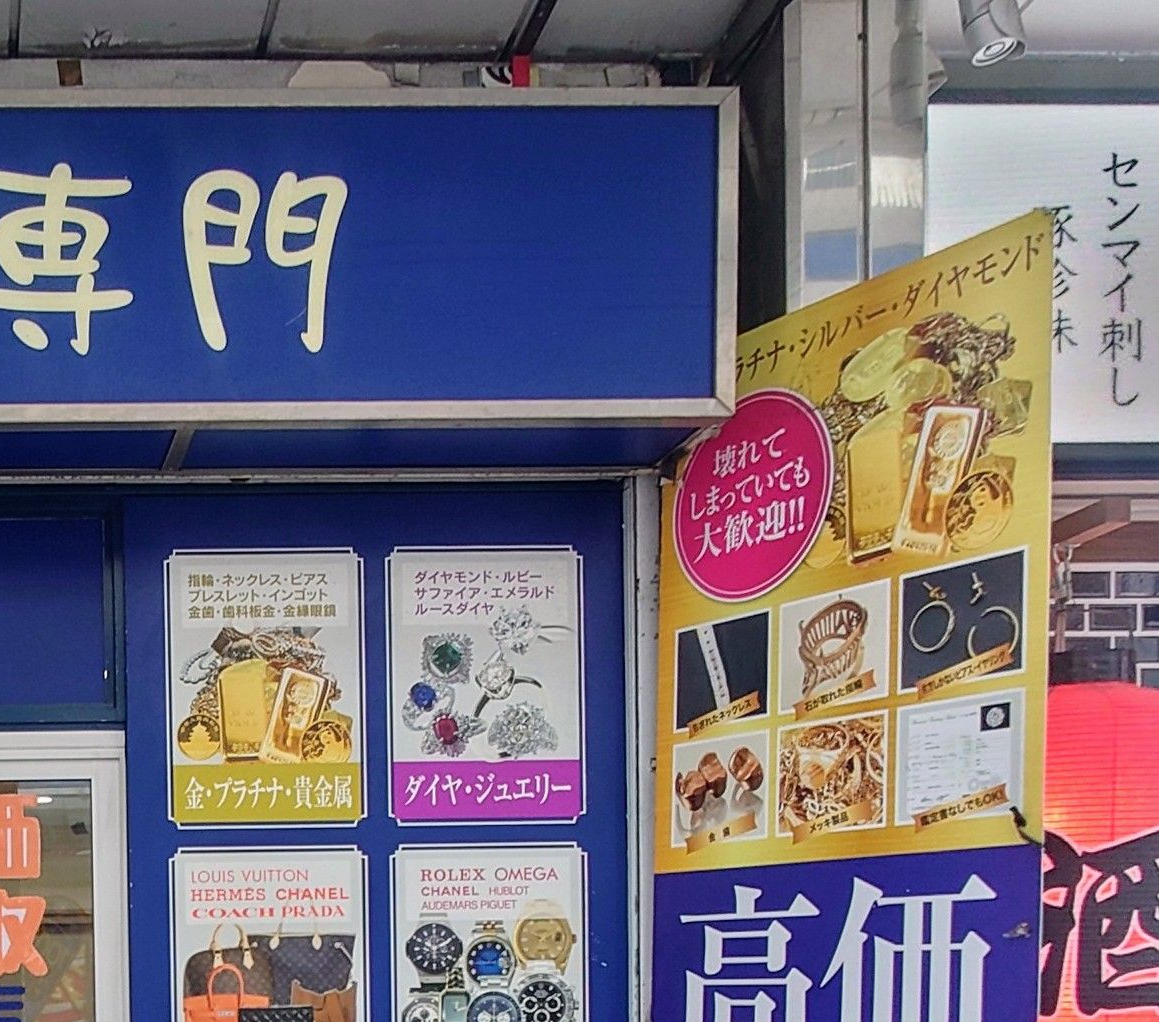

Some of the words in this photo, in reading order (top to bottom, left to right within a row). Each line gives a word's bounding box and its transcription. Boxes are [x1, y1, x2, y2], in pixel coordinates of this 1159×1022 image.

[1100, 152, 1144, 408] センマイ刺し
[713, 427, 788, 479] 壊れて
[689, 458, 811, 521] しまっていても
[693, 496, 806, 565] 大歓迎!!
[414, 570, 542, 585] ダイヤモンド・ルビー
[189, 588, 328, 603] ブレスレット・インゴット
[414, 585, 555, 600] サファイア・エメラルド
[414, 602, 494, 616] ルースダイヤ
[185, 775, 352, 810] 金・プラチナ・貴金属
[404, 773, 572, 807] ダイヤ・ジュエリー
[191, 870, 235, 883] LOUIS
[242, 868, 309, 882] VUITTON
[420, 868, 485, 882] ROLEX
[494, 867, 558, 881] OMEGA
[275, 887, 350, 900] CHANEL
[421, 885, 479, 897] CHANEL
[488, 885, 529, 896] HUBLOT
[192, 907, 275, 919] COACH
[281, 905, 345, 918] PRADA
[421, 900, 478, 911] AUDEMARS
[480, 899, 517, 910] PIGUET
